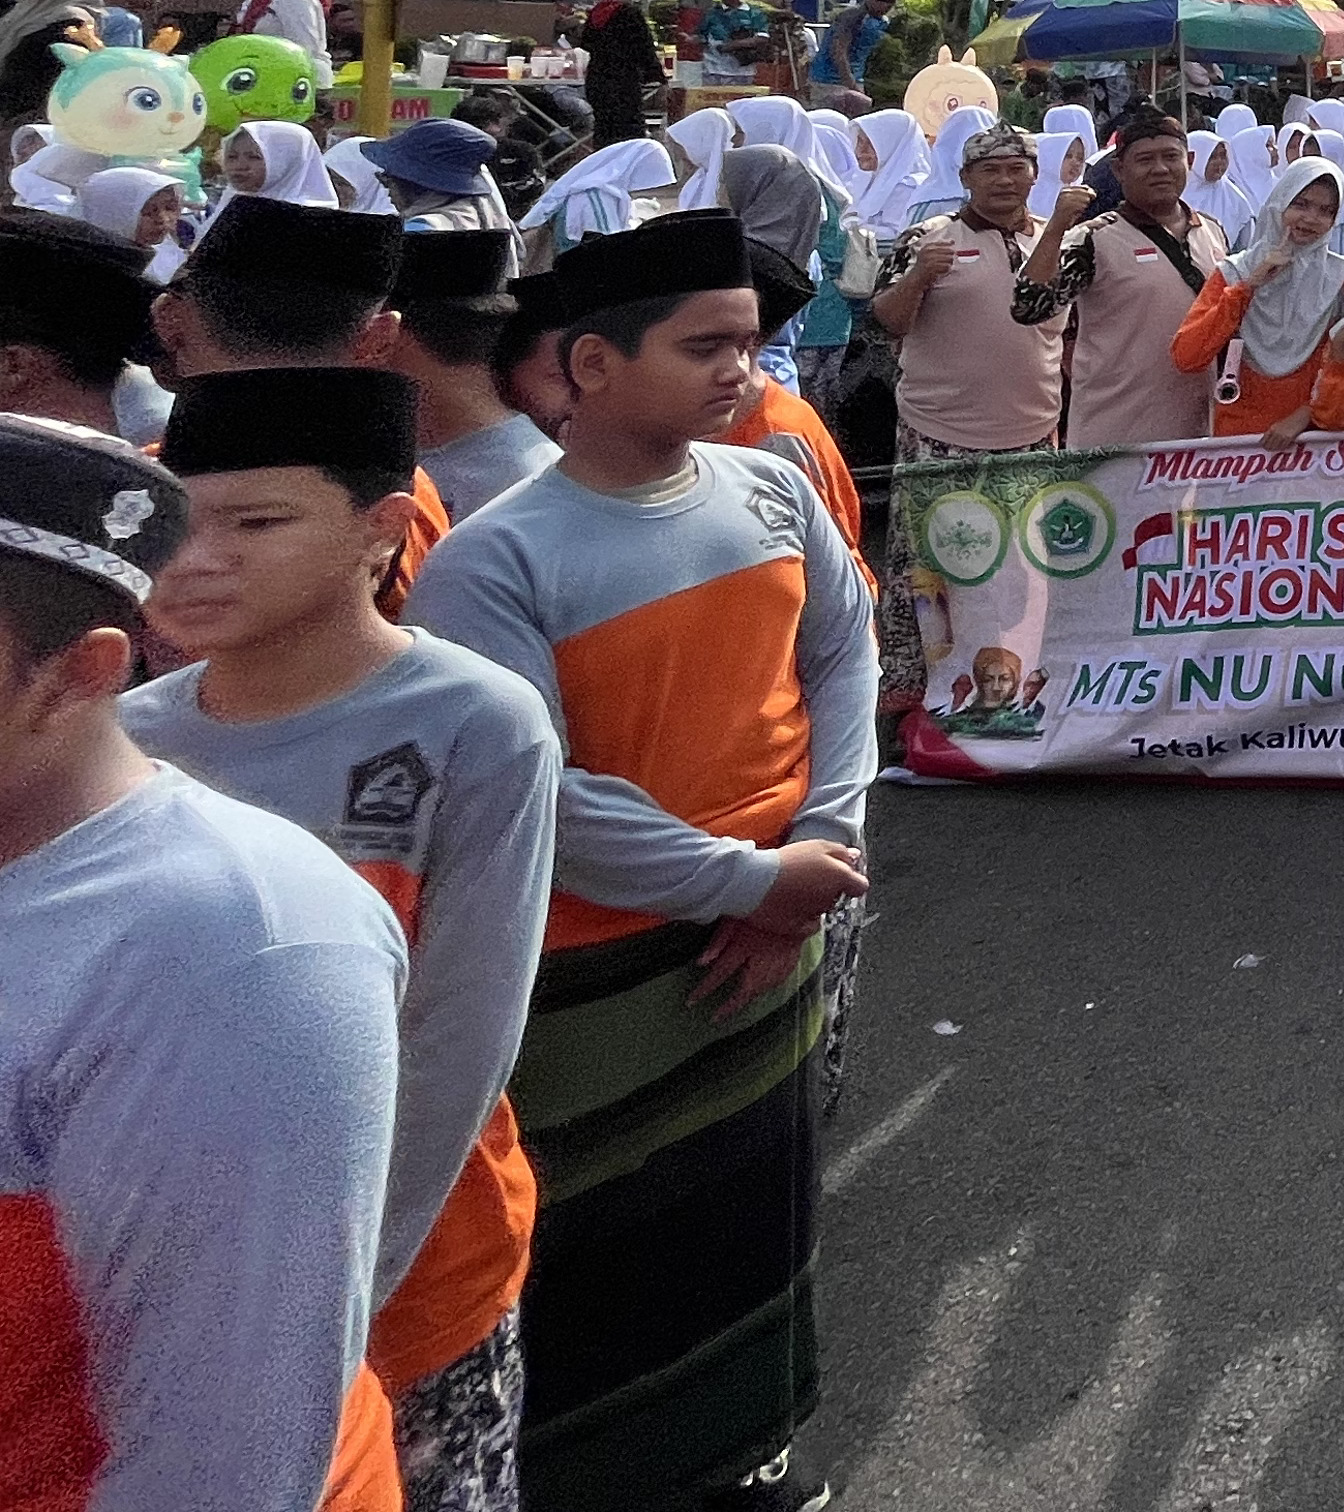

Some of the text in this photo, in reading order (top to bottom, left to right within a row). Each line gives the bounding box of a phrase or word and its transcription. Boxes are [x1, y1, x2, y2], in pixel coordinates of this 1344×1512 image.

[1146, 443, 1313, 486] Mlampah
[1188, 514, 1309, 568] HARI
[1066, 659, 1162, 708] MTs
[1179, 654, 1273, 703] NU
[1129, 734, 1229, 760] Jetak
